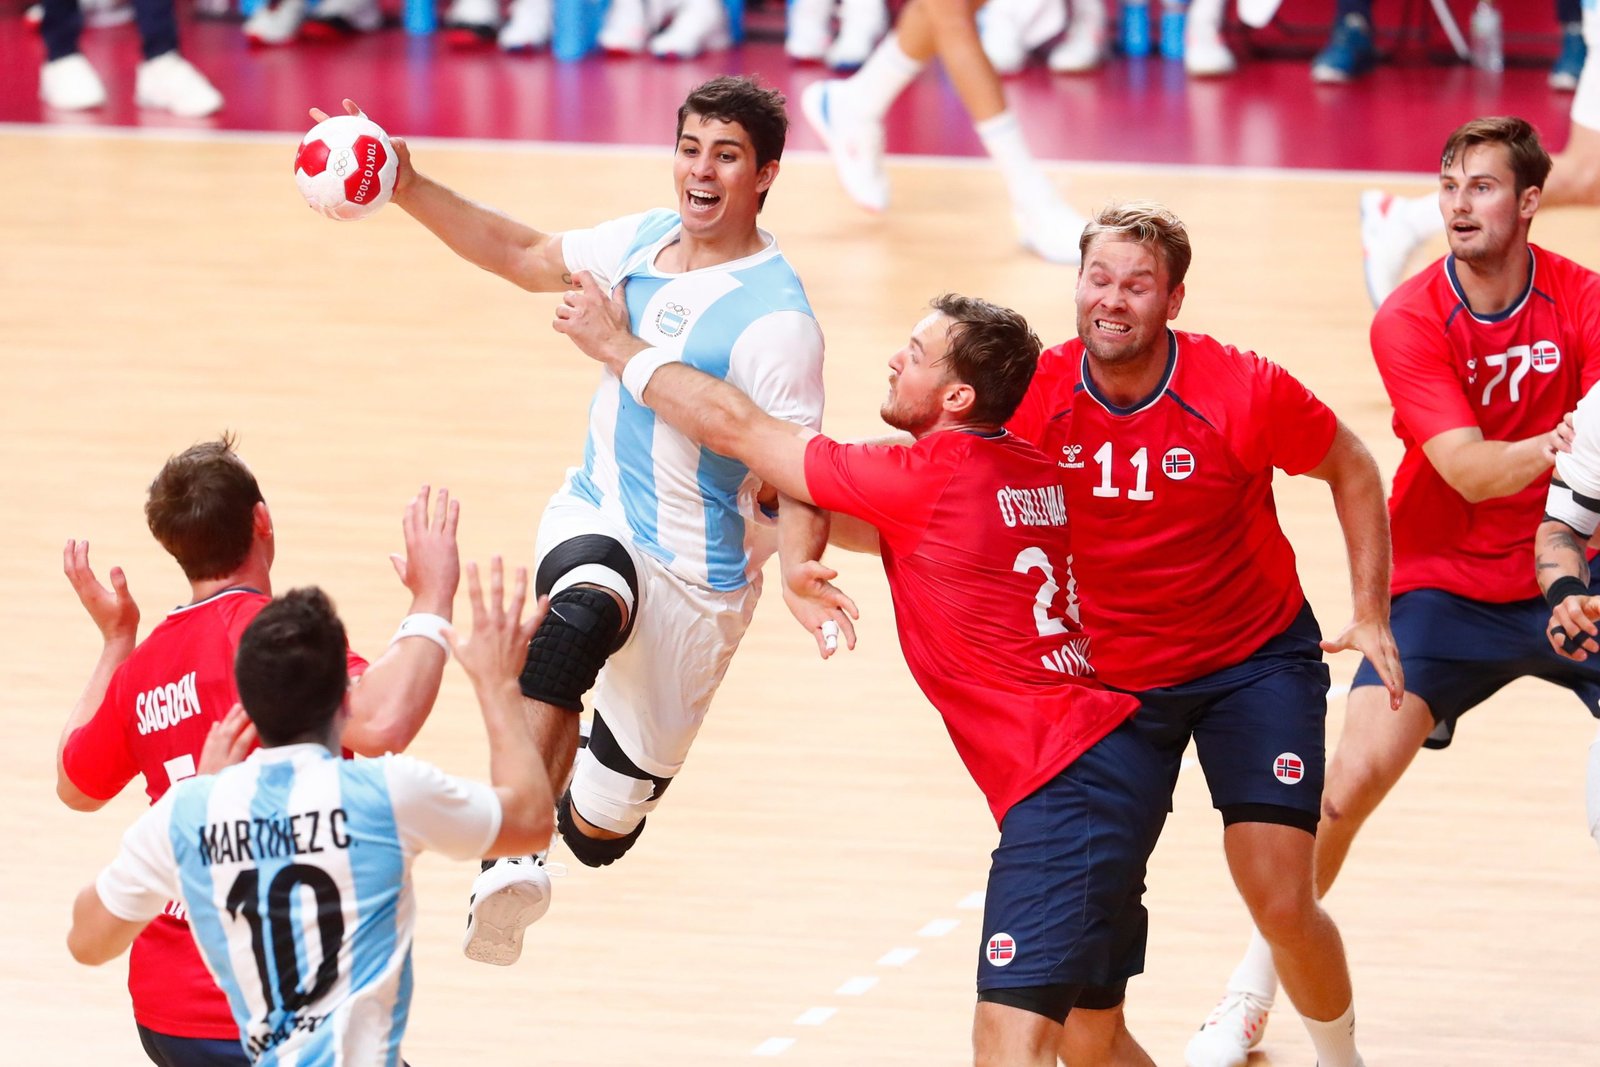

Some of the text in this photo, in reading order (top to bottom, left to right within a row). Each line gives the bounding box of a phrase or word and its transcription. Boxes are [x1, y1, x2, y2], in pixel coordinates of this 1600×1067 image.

[354, 143, 377, 202] TOKYO 2020
[1481, 344, 1531, 406] 77
[1092, 441, 1154, 501] 11
[330, 808, 359, 848] C.
[226, 863, 346, 1023] 10
